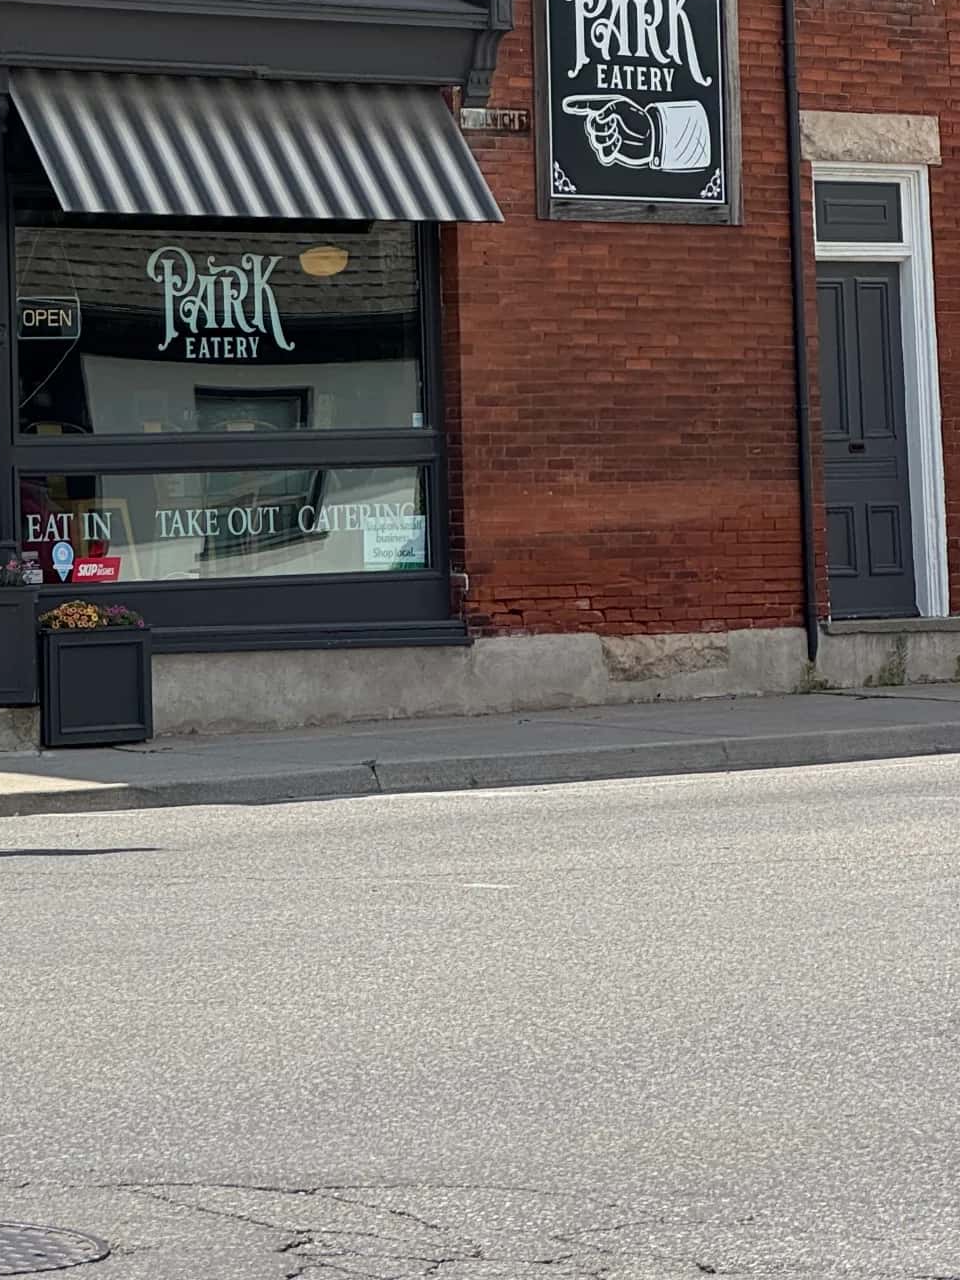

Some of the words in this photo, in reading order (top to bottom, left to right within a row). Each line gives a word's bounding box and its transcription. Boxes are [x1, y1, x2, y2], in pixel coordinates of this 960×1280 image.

[597, 64, 675, 92] EATERY
[146, 246, 295, 351] PARK
[22, 308, 73, 327] OPEN
[186, 336, 259, 359] EATERY
[26, 512, 74, 542] EAT
[82, 512, 112, 540] IN
[155, 508, 220, 537] TAKE
[227, 506, 279, 535] OUT
[78, 563, 97, 577] SKIP
